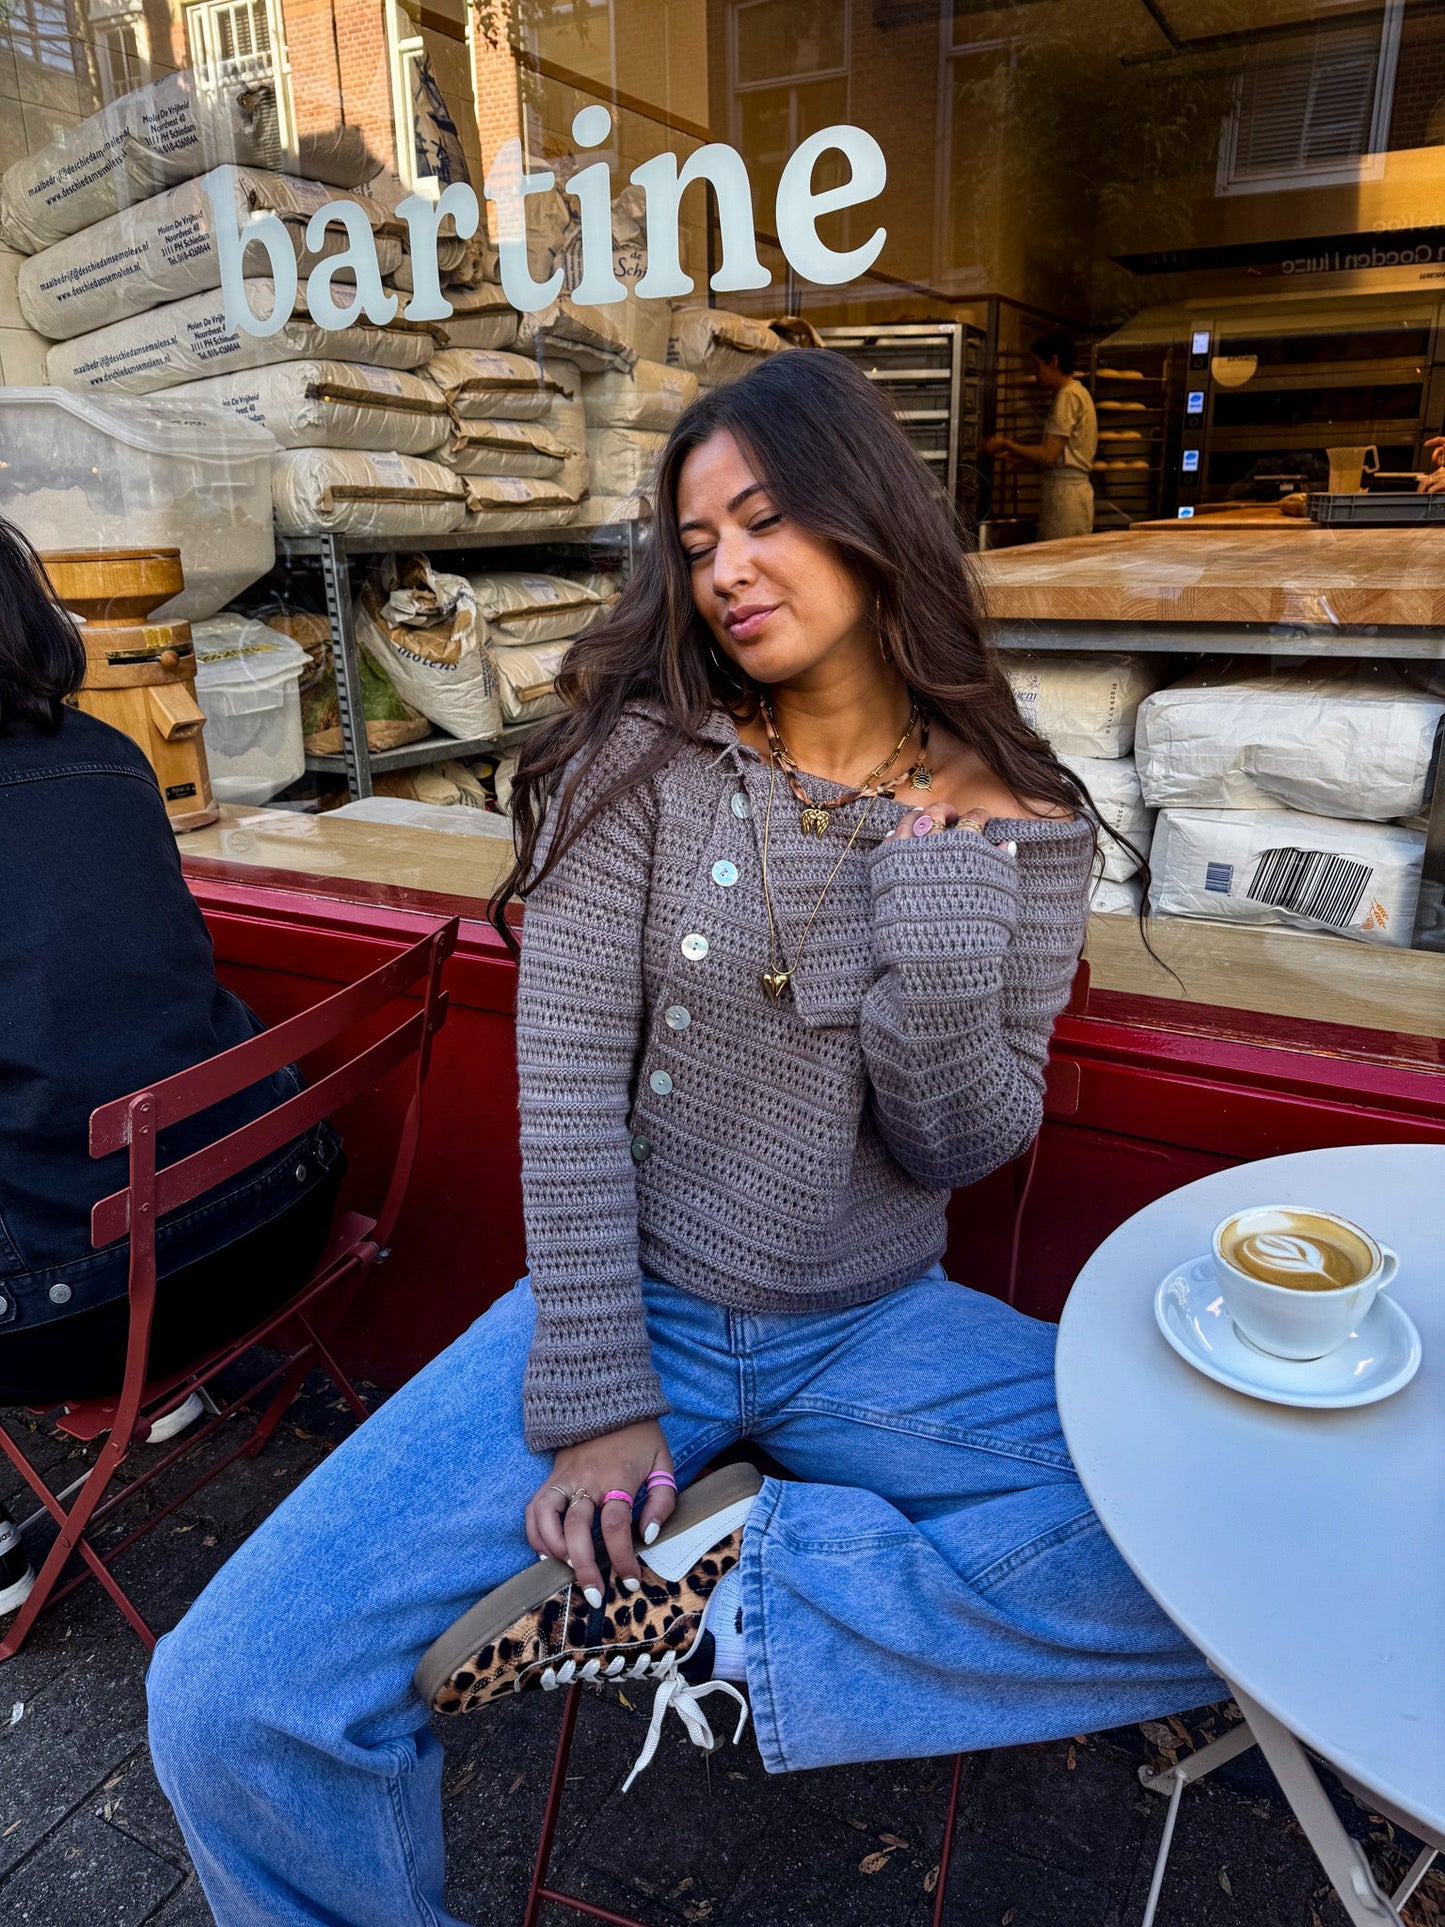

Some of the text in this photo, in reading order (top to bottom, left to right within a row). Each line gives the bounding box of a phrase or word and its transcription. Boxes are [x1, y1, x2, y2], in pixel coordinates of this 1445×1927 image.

[169, 124, 196, 139] Schiedam
[157, 224, 174, 236] Molen
[174, 219, 182, 229] De
[201, 104, 888, 338] bartine
[165, 228, 193, 243] Noordvest
[174, 241, 184, 252] PH
[183, 233, 210, 248] Schiedam
[56, 261, 142, 302] www.deschiedamsemolens.nl
[203, 318, 211, 326] De
[203, 338, 213, 348] PH
[73, 335, 178, 375] maalbedrijf@deschiedamsemolens.nl
[90, 353, 172, 385] www.deschiedamsemolens.nl
